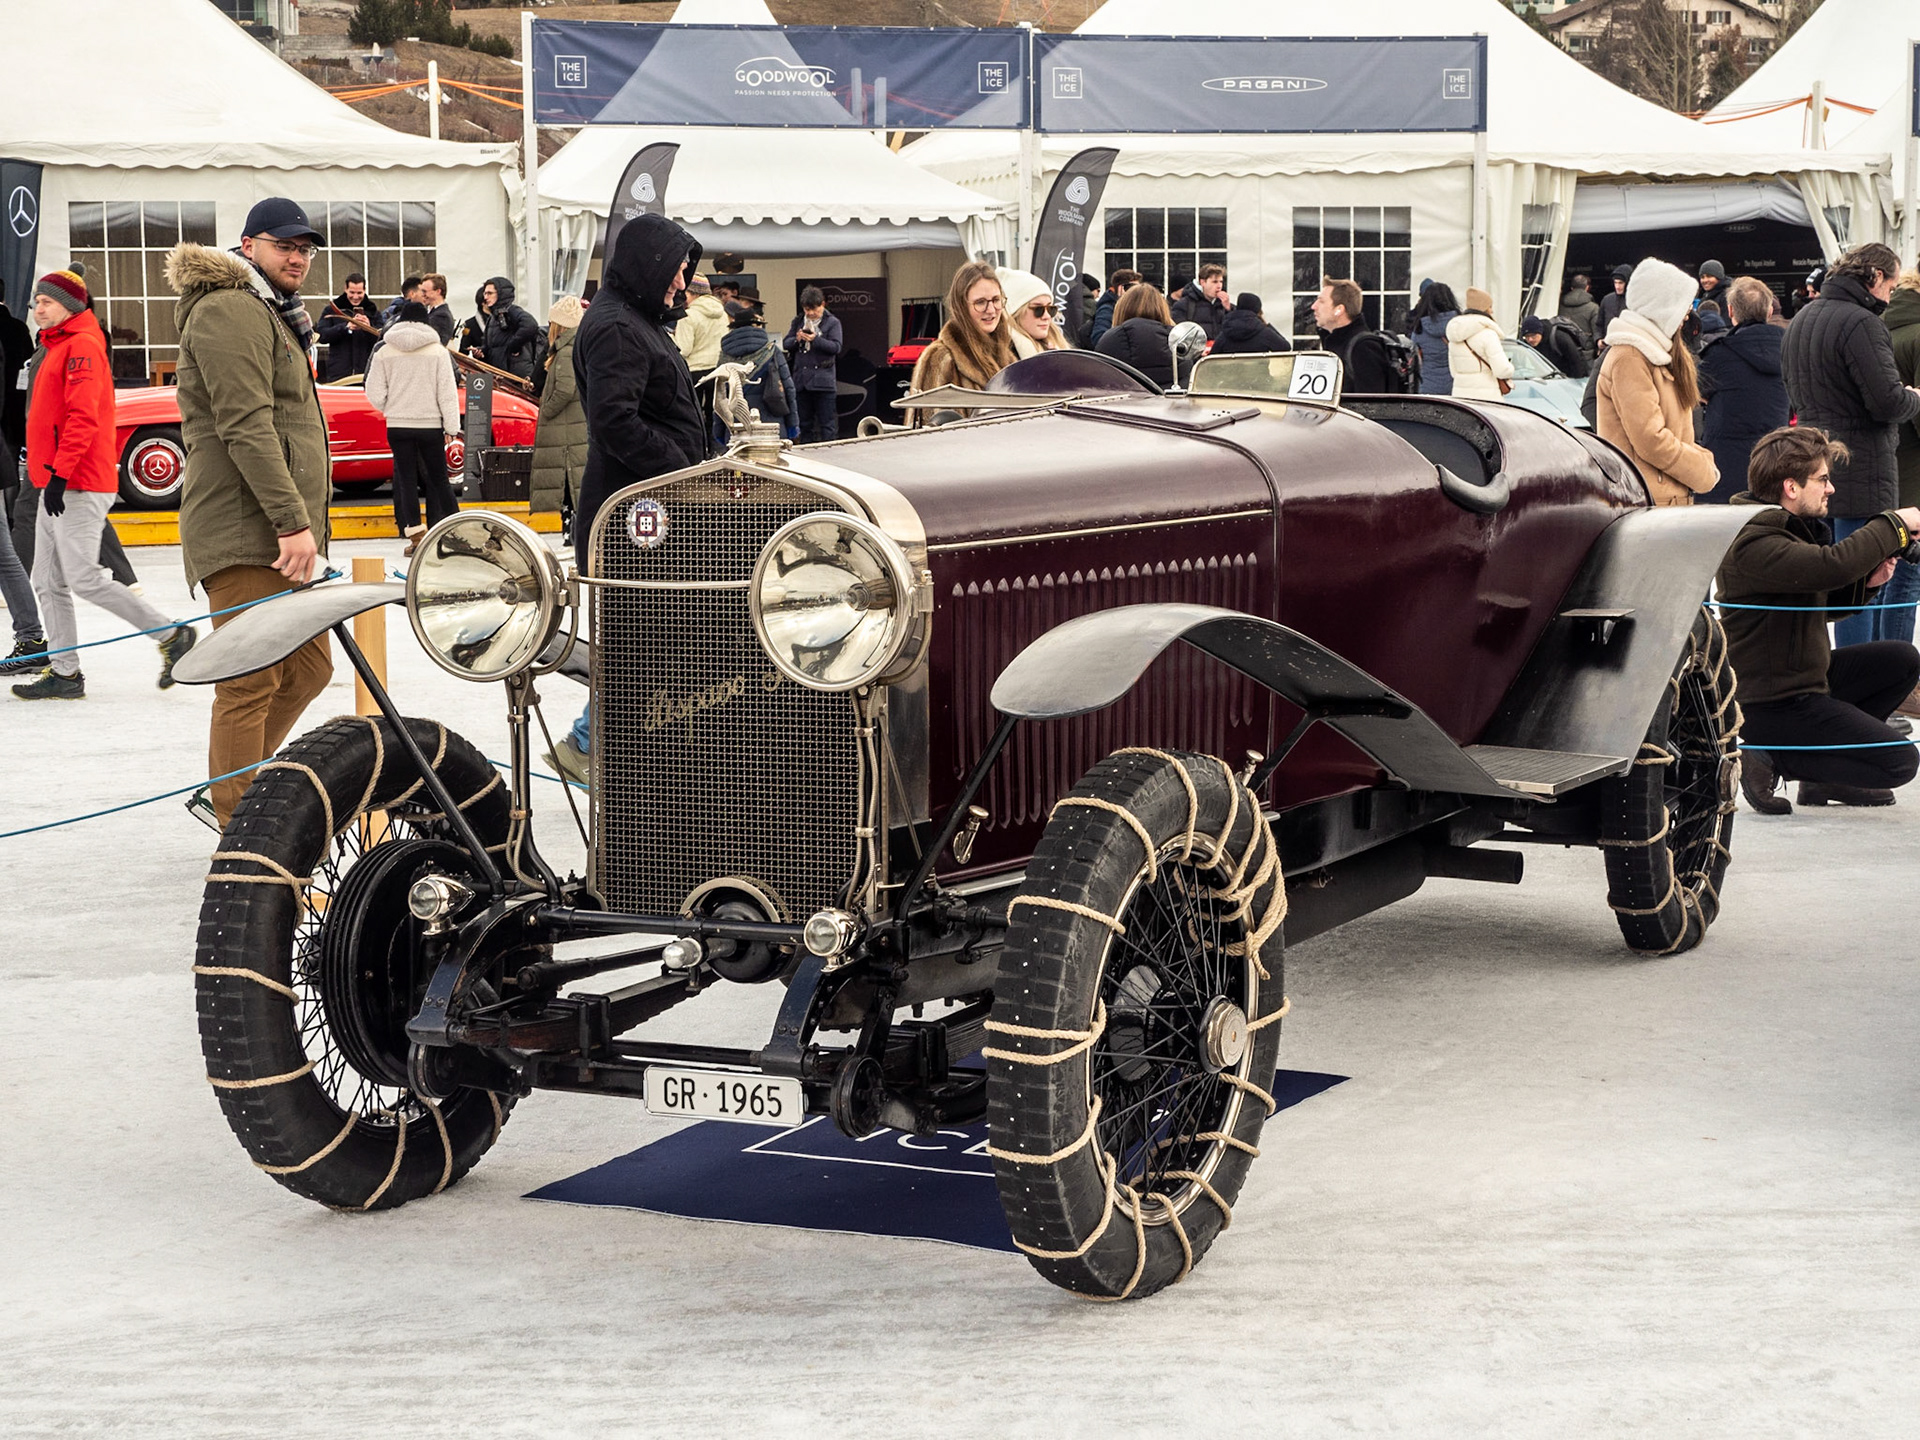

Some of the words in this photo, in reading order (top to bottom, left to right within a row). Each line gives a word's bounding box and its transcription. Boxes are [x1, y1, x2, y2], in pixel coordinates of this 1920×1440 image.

[561, 62, 581, 72] THE
[563, 72, 581, 82] ICE
[984, 68, 1003, 78] THE
[735, 69, 835, 88] GOODWOOL
[986, 78, 1003, 87] ICE
[1058, 74, 1077, 83] THE
[1449, 75, 1466, 83] THE
[1060, 83, 1077, 92] ICE
[1223, 80, 1307, 89] PAGANI
[1450, 84, 1466, 93] ICE
[1070, 205, 1080, 214] THE
[1058, 209, 1086, 222] WOOLMARK
[1058, 215, 1084, 227] COMPANY
[1296, 373, 1328, 395] 20
